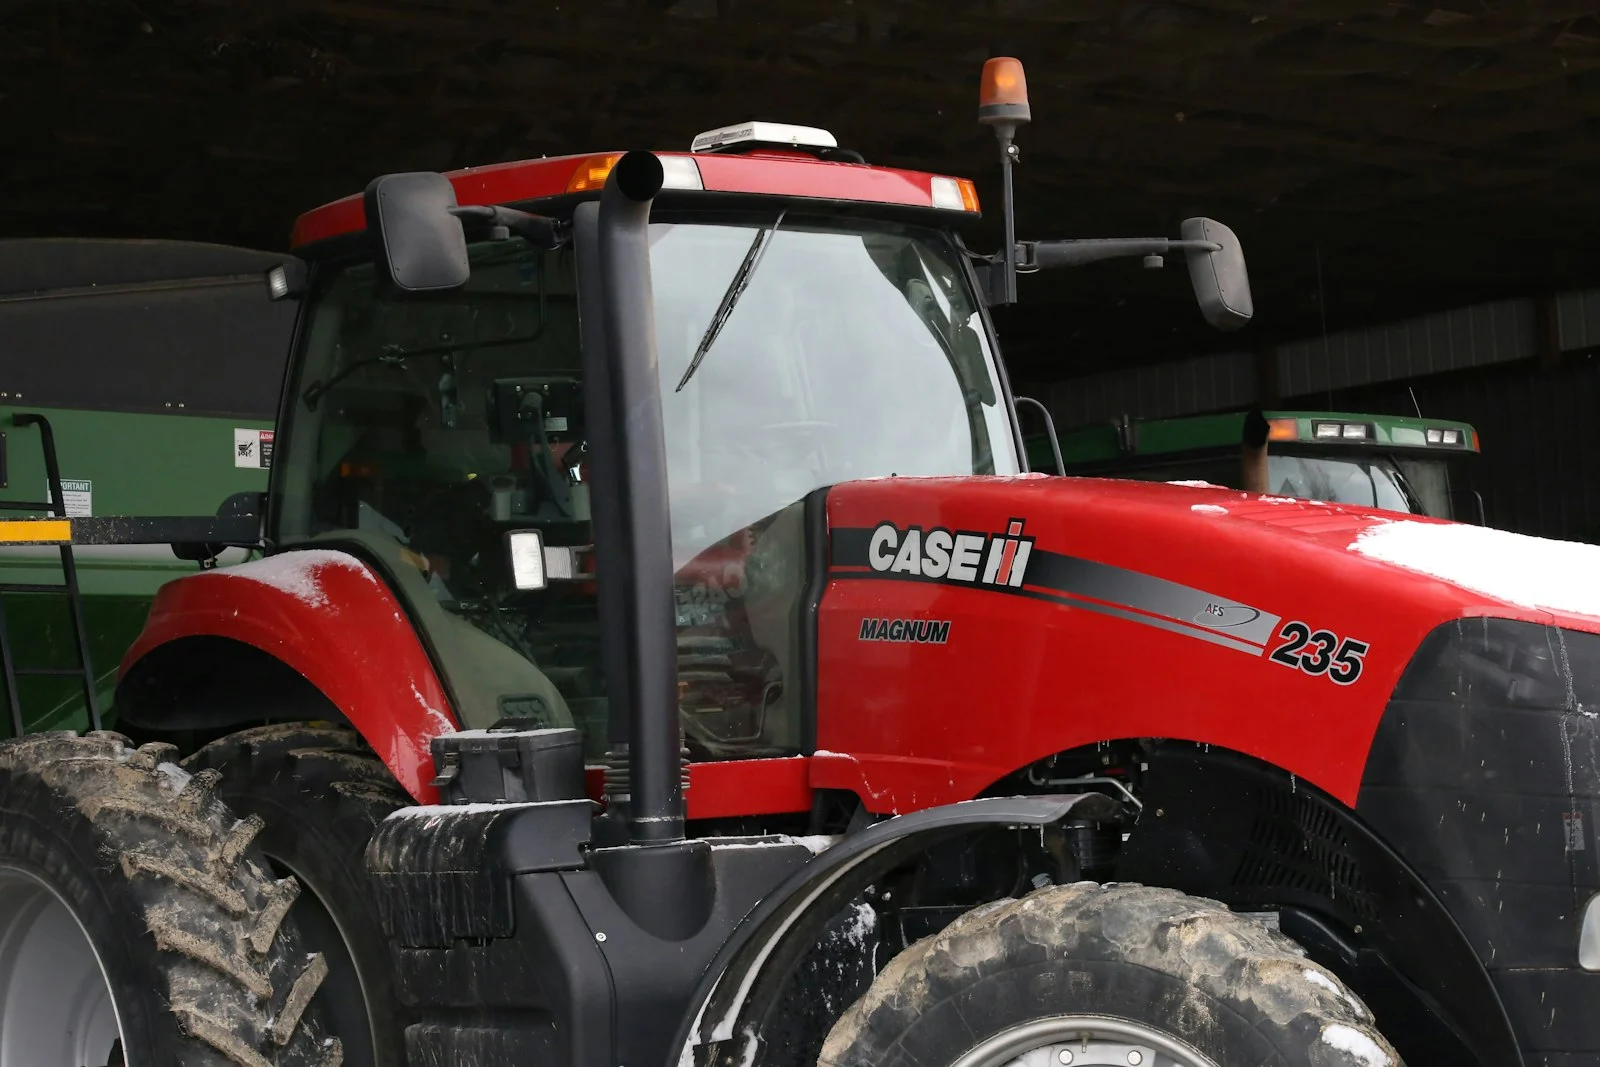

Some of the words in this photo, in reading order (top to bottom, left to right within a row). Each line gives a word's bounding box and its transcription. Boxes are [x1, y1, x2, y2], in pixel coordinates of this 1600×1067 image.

[60, 481, 90, 490] ORTANT
[869, 524, 985, 581] CASE
[1204, 602, 1225, 617] AFS
[858, 618, 951, 644] MAGNUM
[1268, 620, 1370, 686] 235
